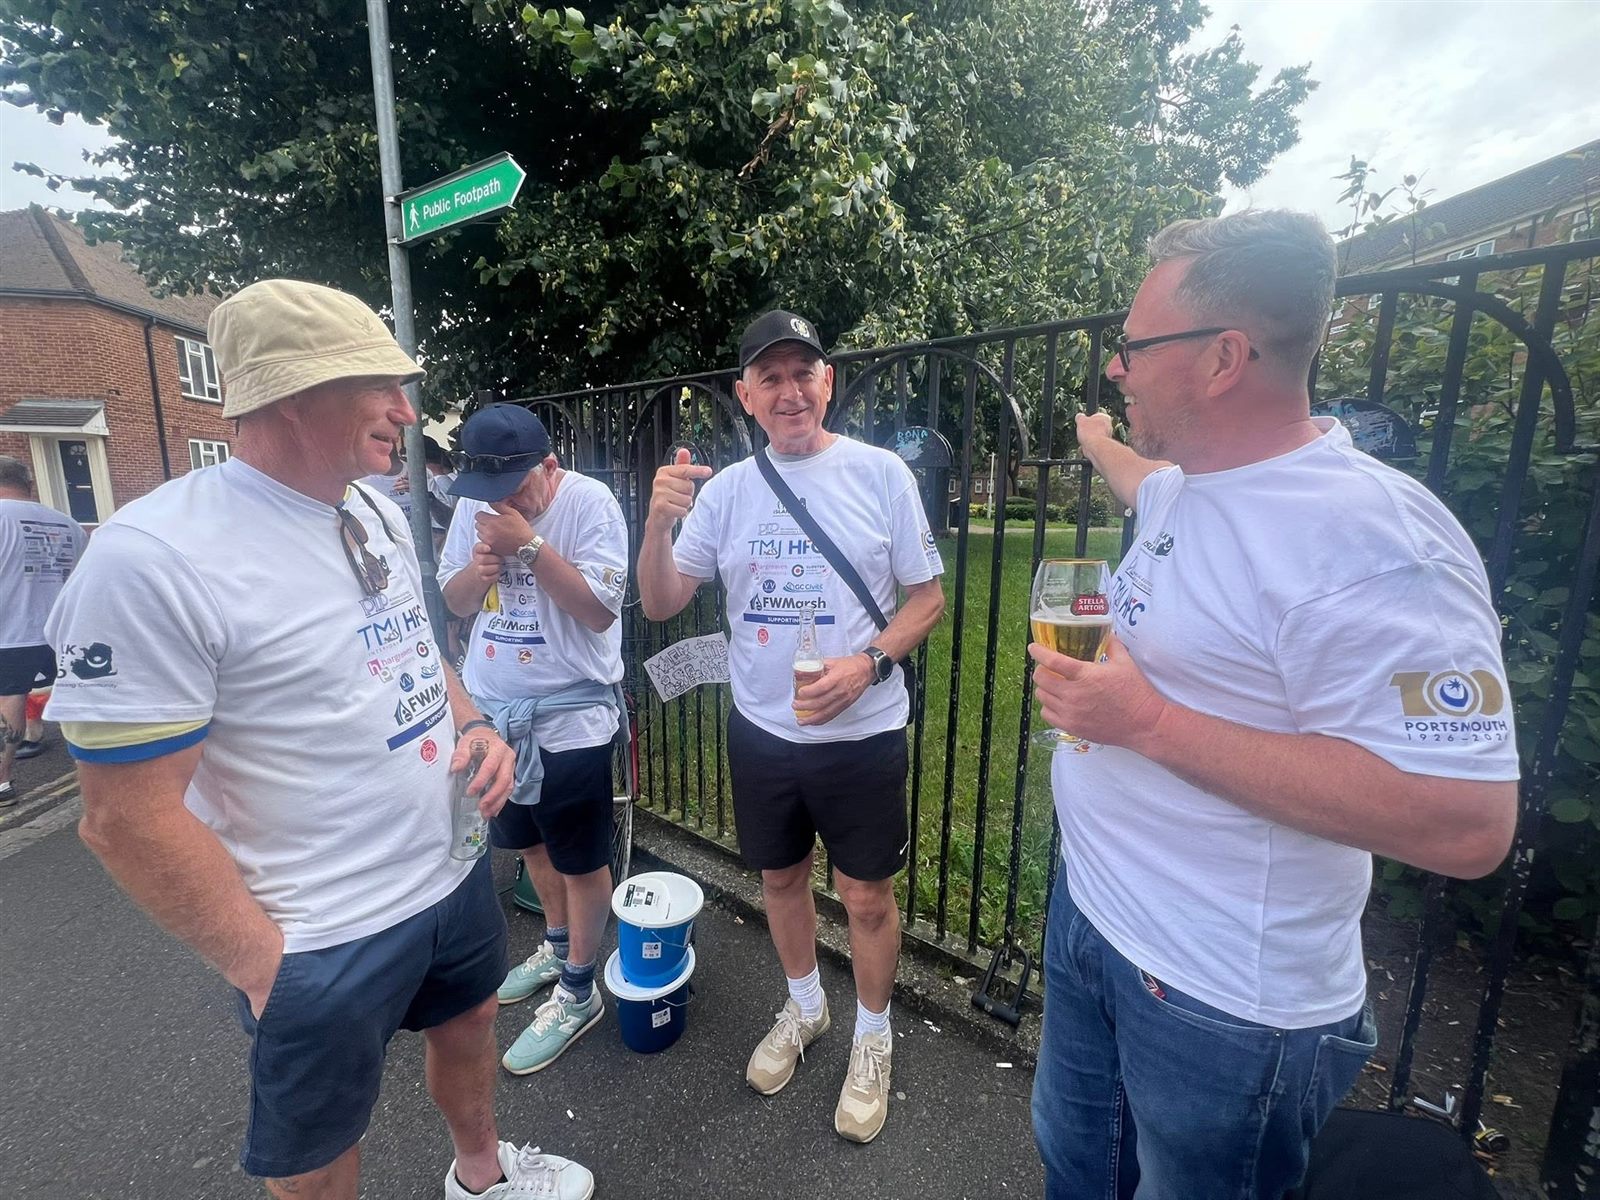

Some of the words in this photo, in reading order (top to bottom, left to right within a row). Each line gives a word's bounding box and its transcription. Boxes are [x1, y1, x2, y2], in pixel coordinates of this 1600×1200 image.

[423, 199, 451, 219] Public
[454, 178, 501, 207] Footpath
[748, 539, 782, 559] TMJ
[762, 596, 826, 609] FWMarsh
[357, 616, 403, 650] TMJ
[1389, 669, 1504, 717] 100
[1405, 720, 1508, 733] PORTSMOUTH
